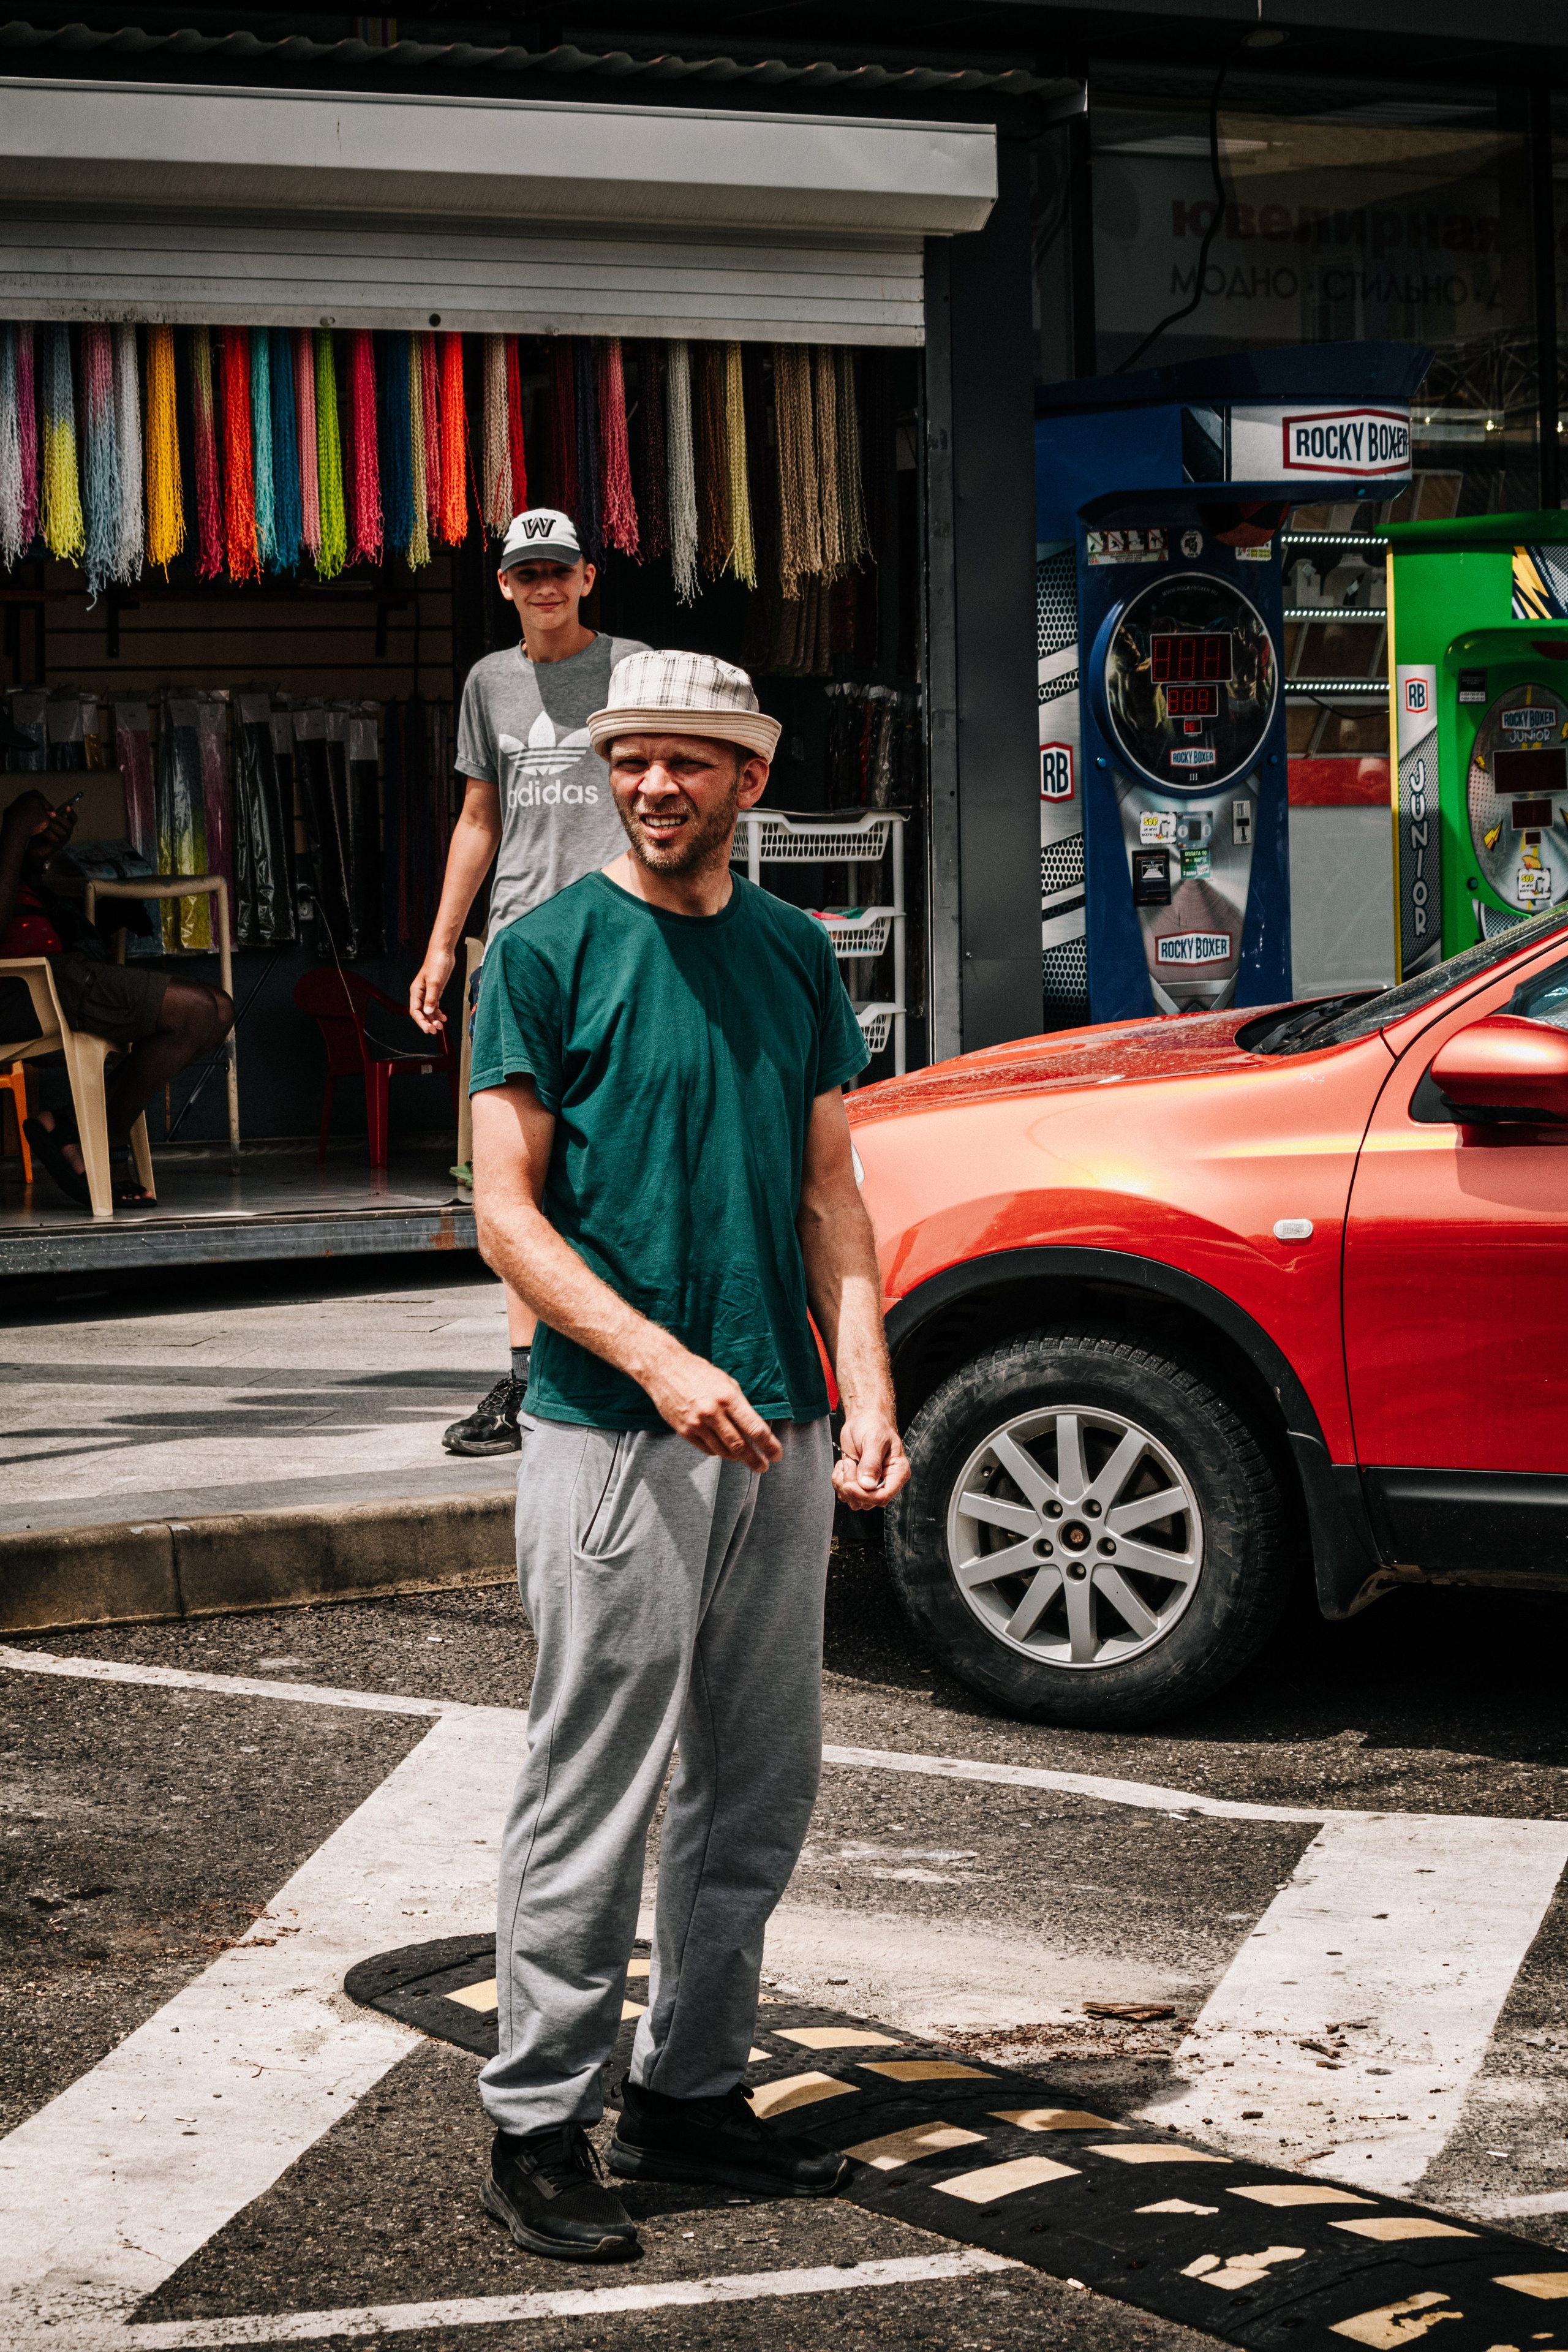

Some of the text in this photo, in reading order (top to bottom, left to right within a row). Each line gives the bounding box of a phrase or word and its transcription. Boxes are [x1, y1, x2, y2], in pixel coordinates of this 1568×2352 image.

[1170, 263, 1298, 301] МОДНО
[1323, 267, 1469, 306] СТИЛЬНО
[1296, 422, 1408, 462] ROCKY BOXER
[521, 517, 556, 540] W
[1408, 683, 1425, 708] RB
[1504, 709, 1555, 728] ROCKY BOXER
[1173, 751, 1213, 764] ROCKY BOXER
[1043, 752, 1068, 793] RB
[507, 778, 598, 809] adidas
[1409, 759, 1428, 937] JUNIOR
[1161, 938, 1227, 959] ROCKY BOXER
